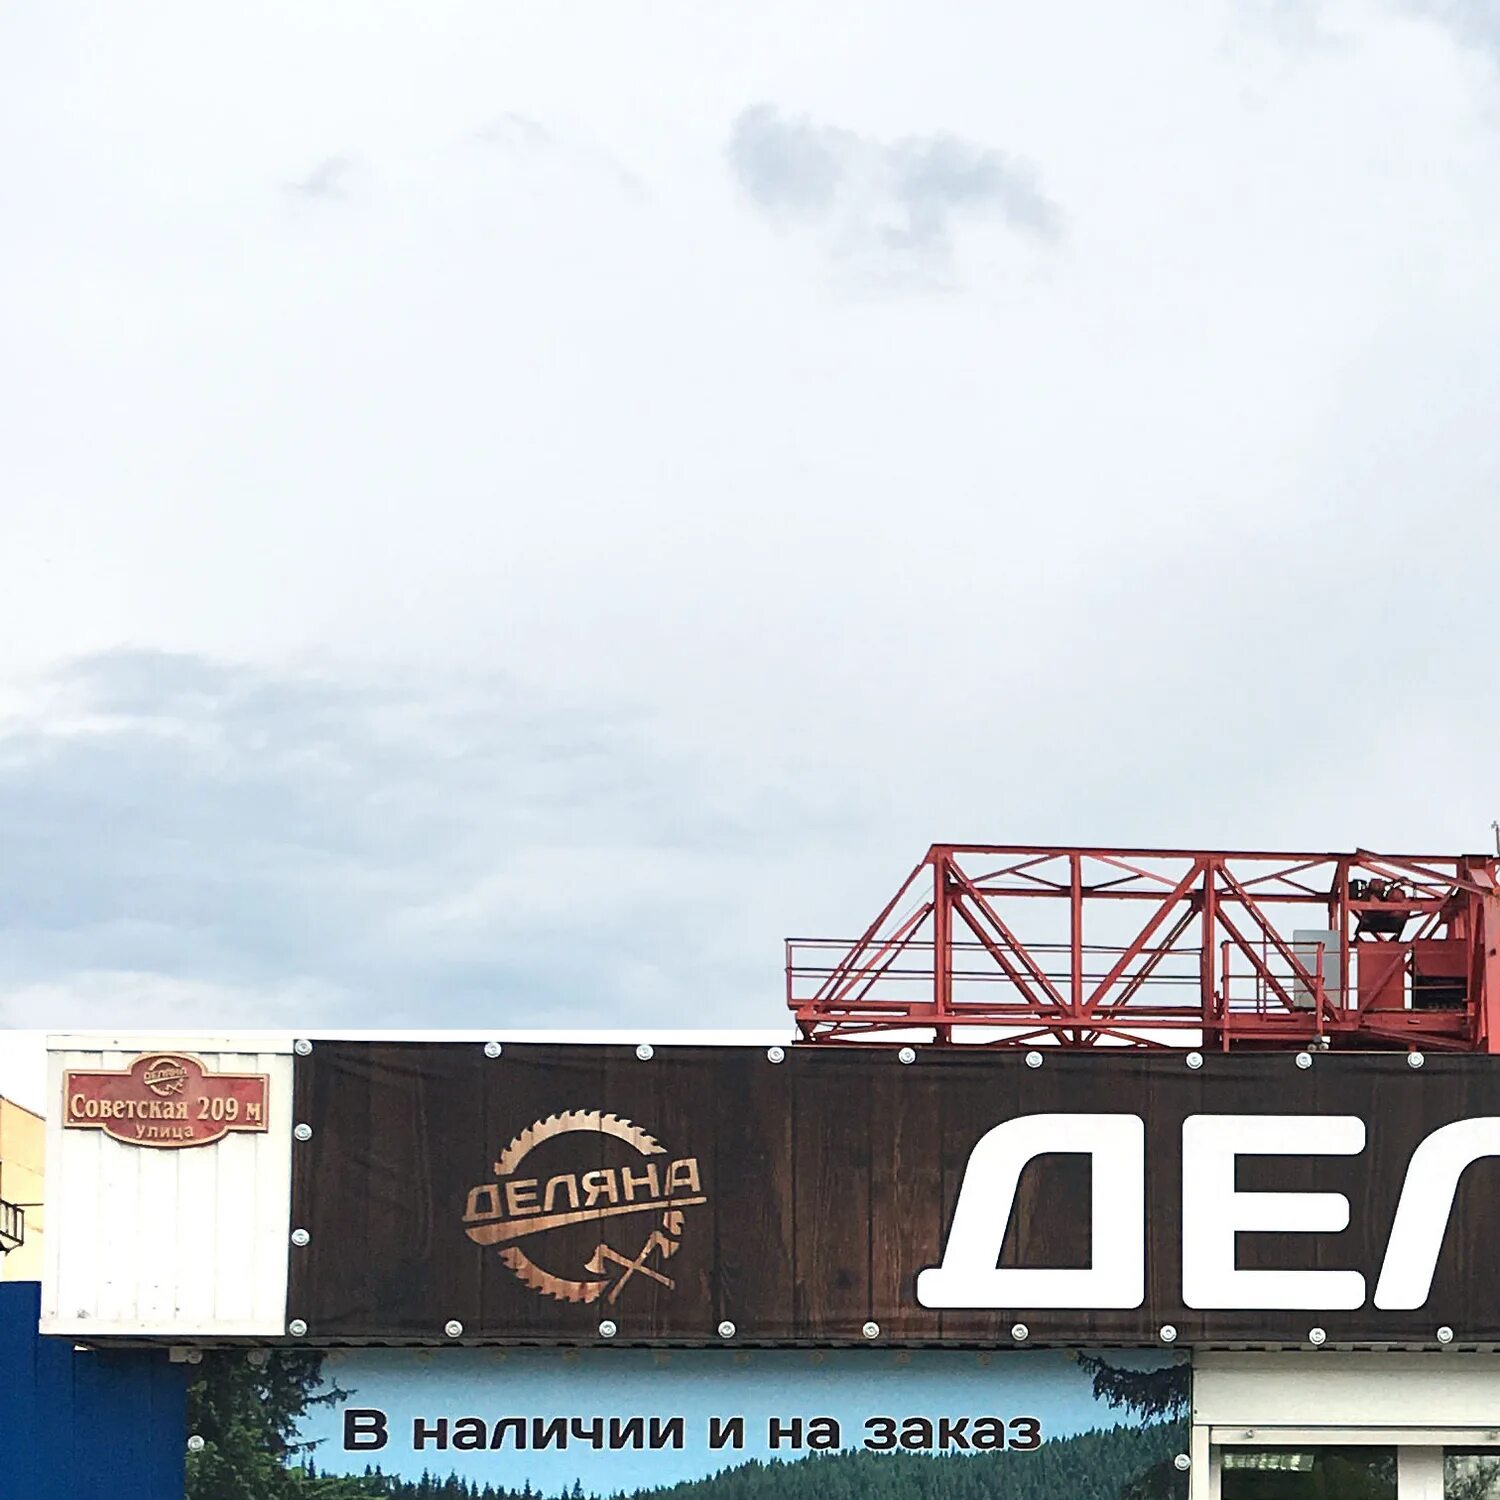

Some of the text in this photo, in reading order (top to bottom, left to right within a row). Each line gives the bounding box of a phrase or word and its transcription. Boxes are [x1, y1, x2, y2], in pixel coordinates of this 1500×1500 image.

[70, 1093, 190, 1120] Советская
[197, 1097, 239, 1121] 209
[135, 1124, 194, 1139] улица
[462, 1157, 702, 1222] ДЕЛЯНА
[342, 1408, 1043, 1451] В наличии и на заказ
